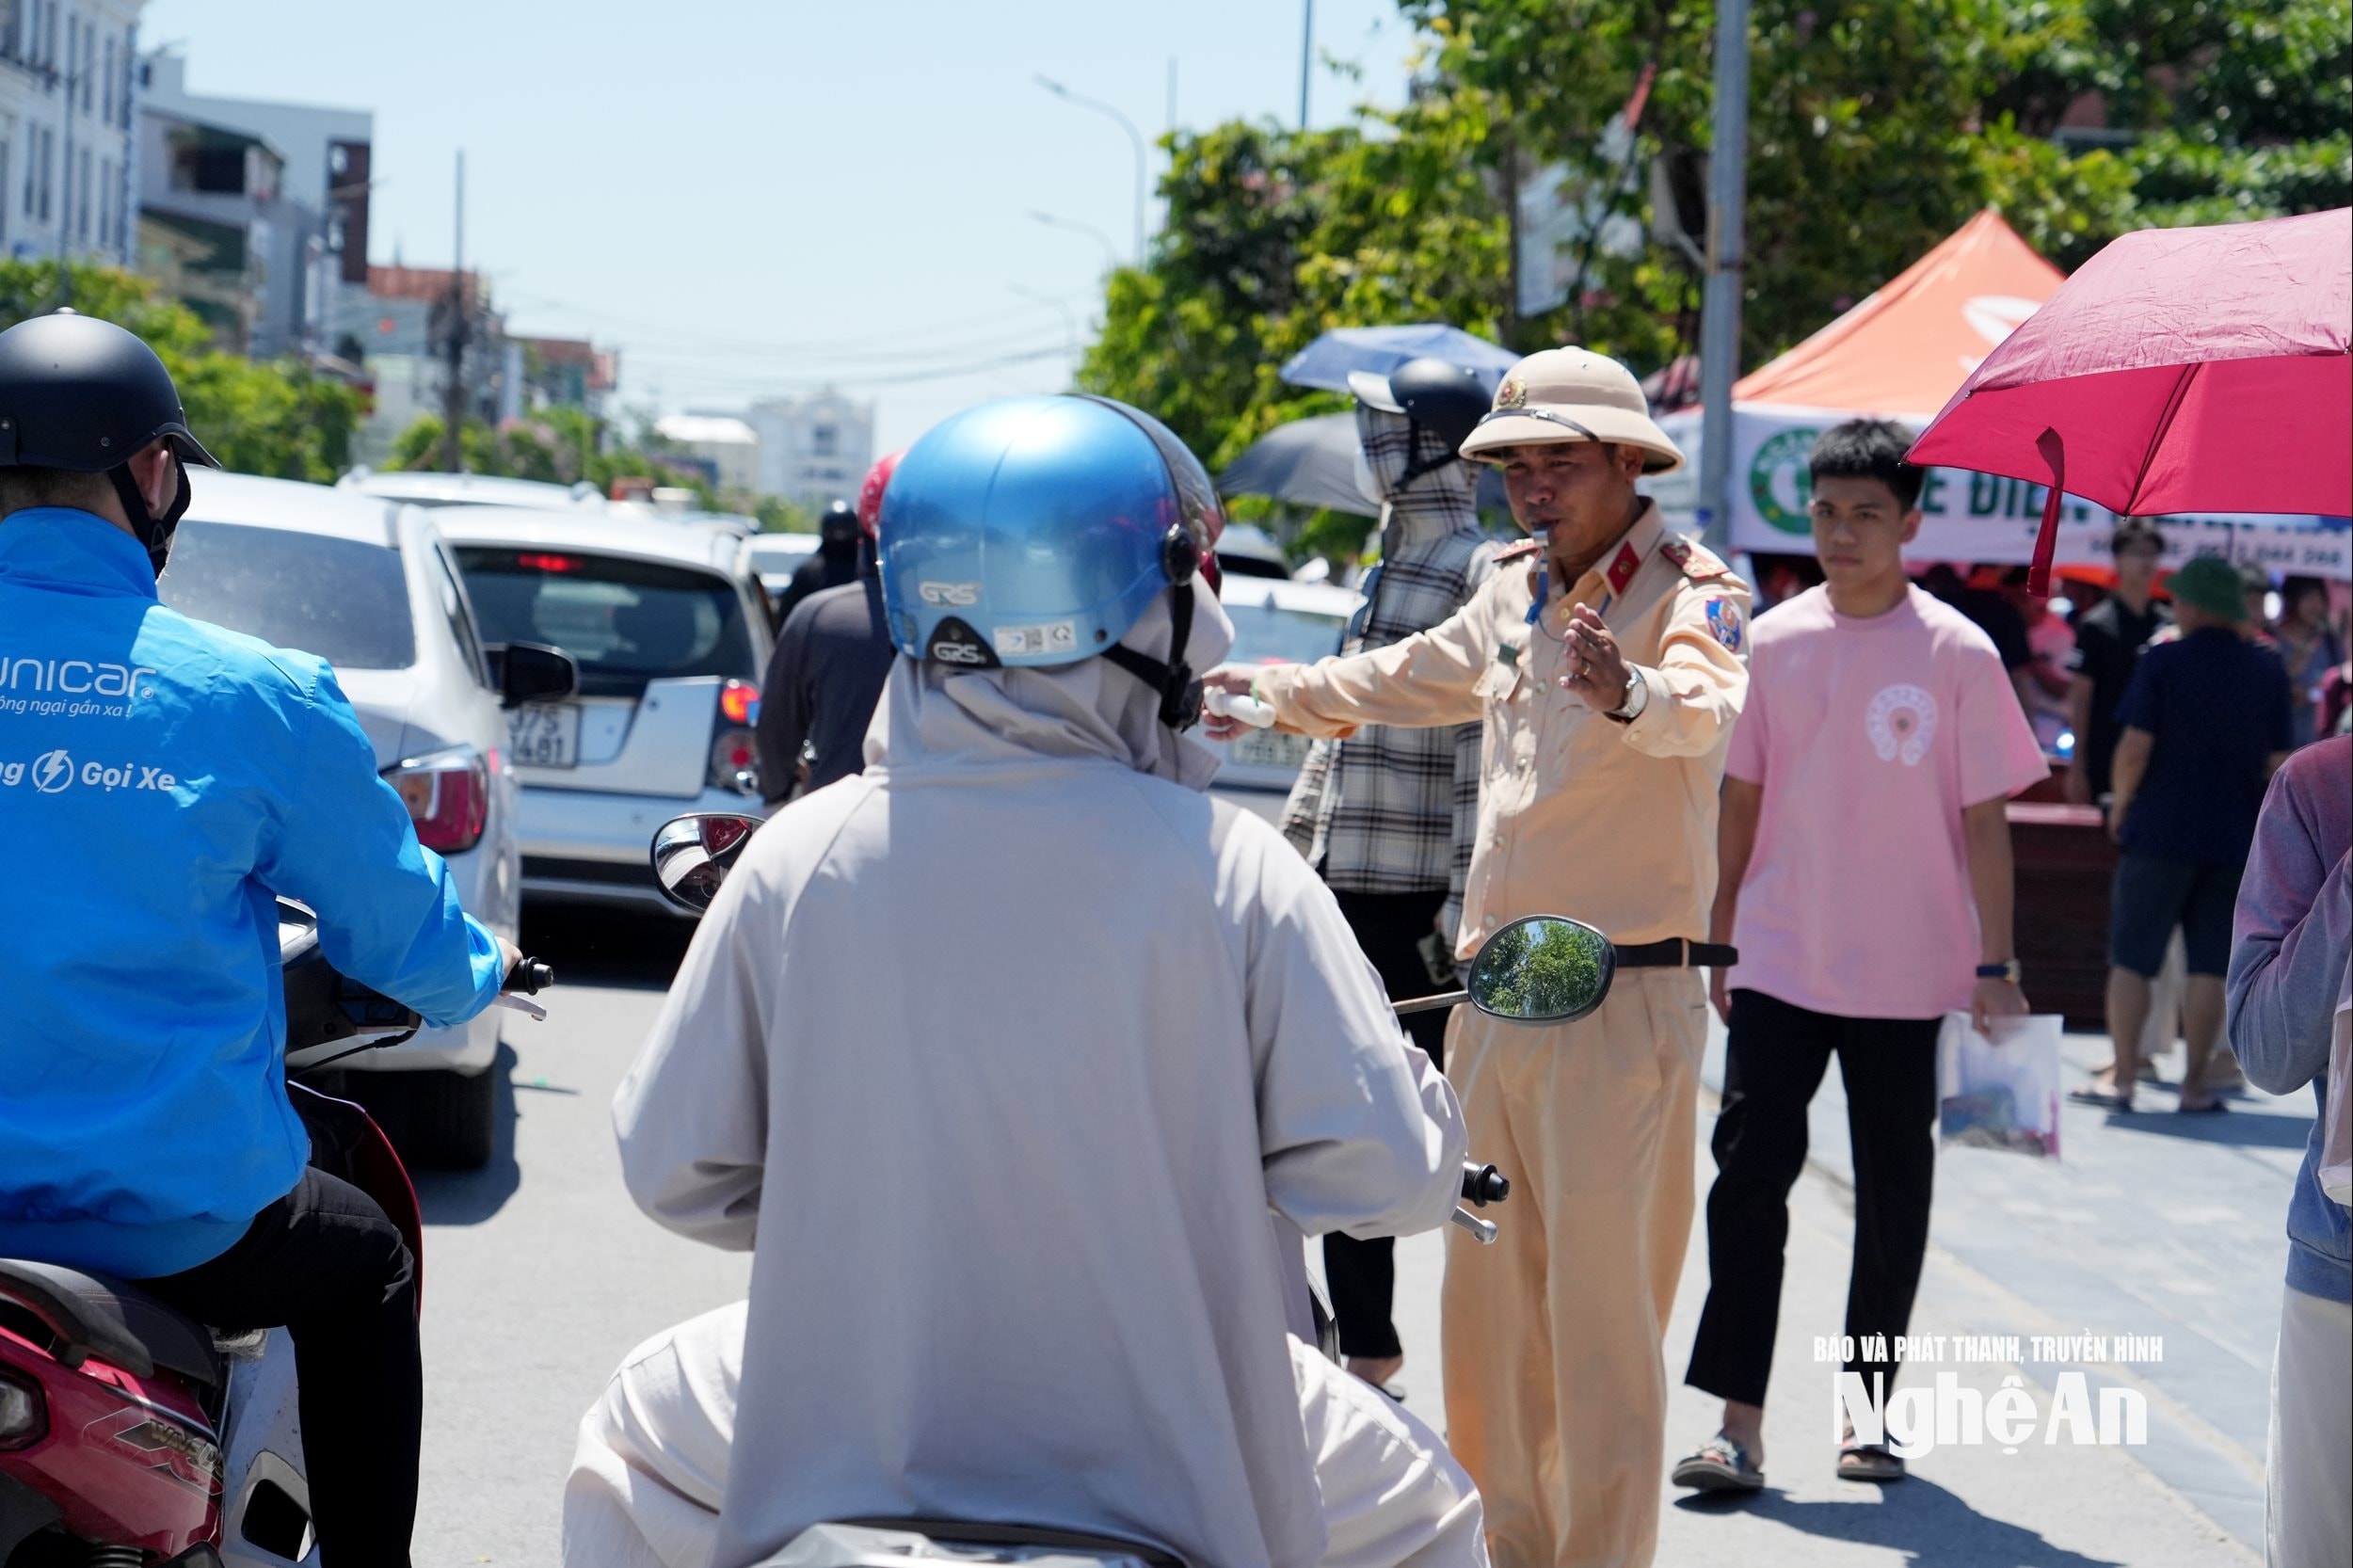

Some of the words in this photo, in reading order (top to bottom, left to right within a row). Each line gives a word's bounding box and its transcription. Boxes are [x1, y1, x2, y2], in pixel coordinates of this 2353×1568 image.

[919, 581, 978, 605] GRS
[933, 641, 980, 664] GRS
[29, 699, 67, 716] ngại
[68, 698, 100, 717] gần
[81, 762, 134, 792] Gọi
[136, 766, 176, 792] Xe
